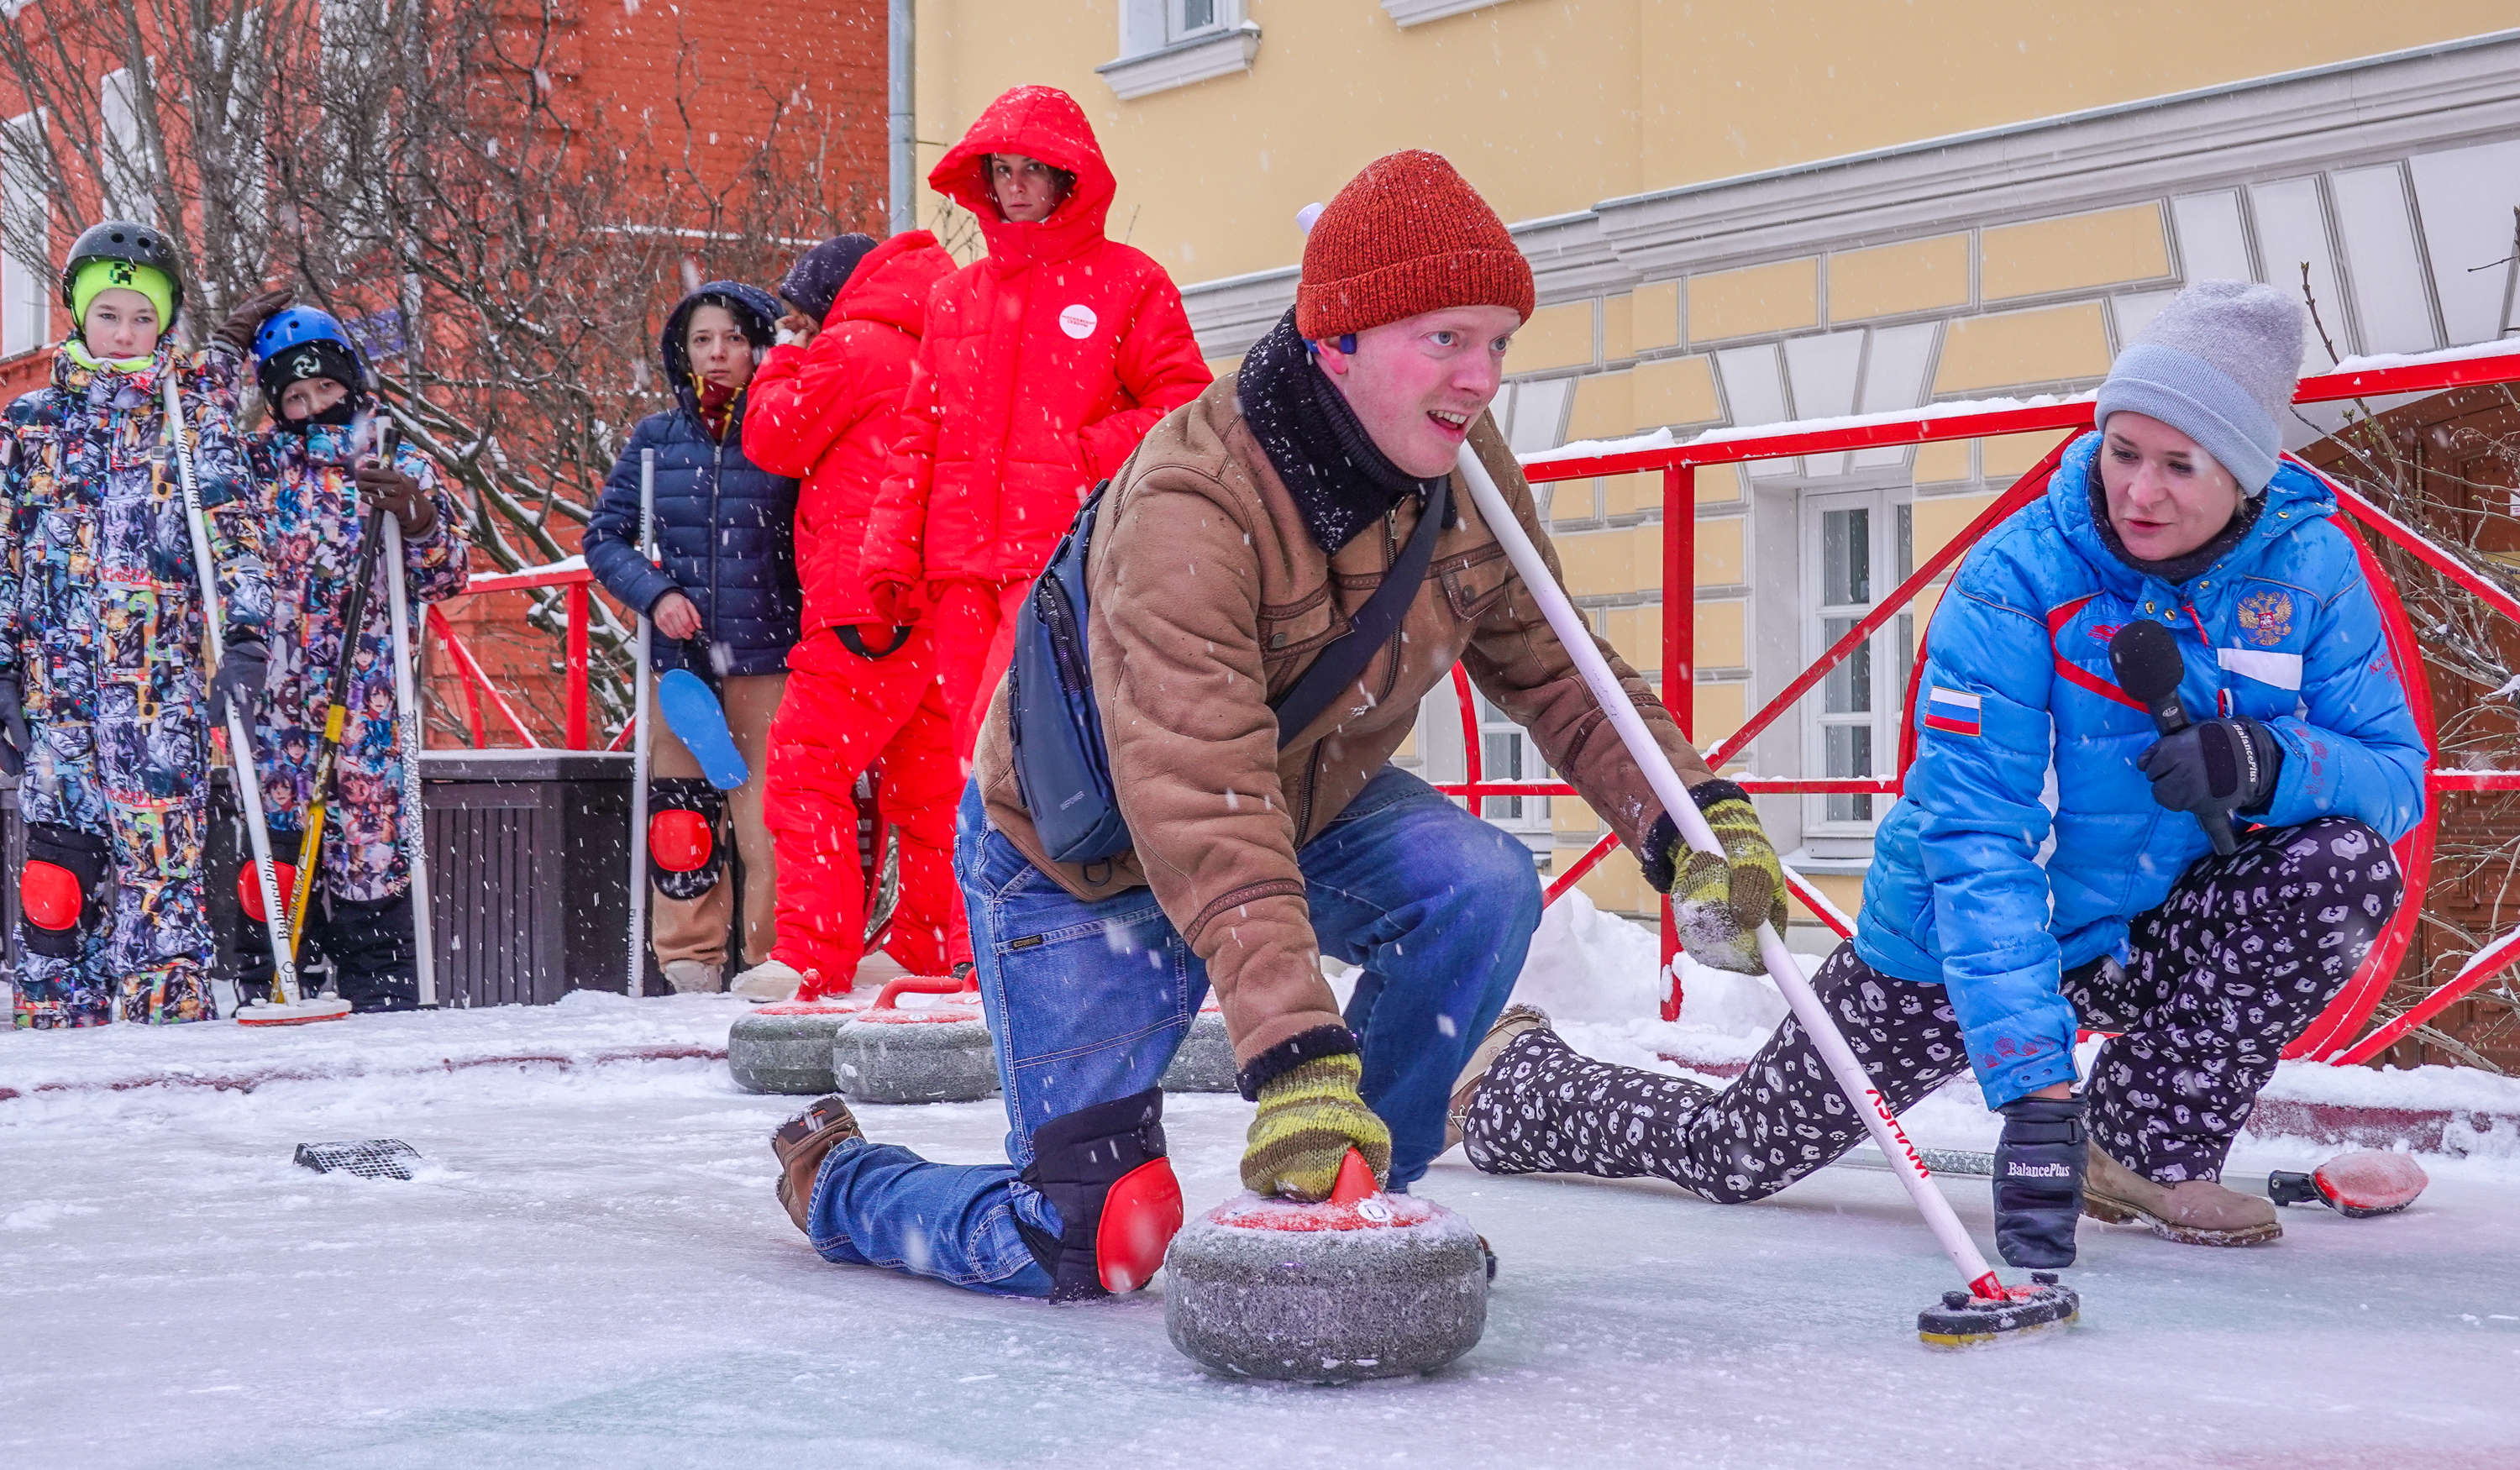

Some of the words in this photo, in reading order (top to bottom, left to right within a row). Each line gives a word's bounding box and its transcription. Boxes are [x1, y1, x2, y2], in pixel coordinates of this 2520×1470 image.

[2231, 724, 2258, 783] BalancePlus
[265, 853, 289, 940] BalancePlus
[2007, 1161, 2071, 1178] BalancePlus
